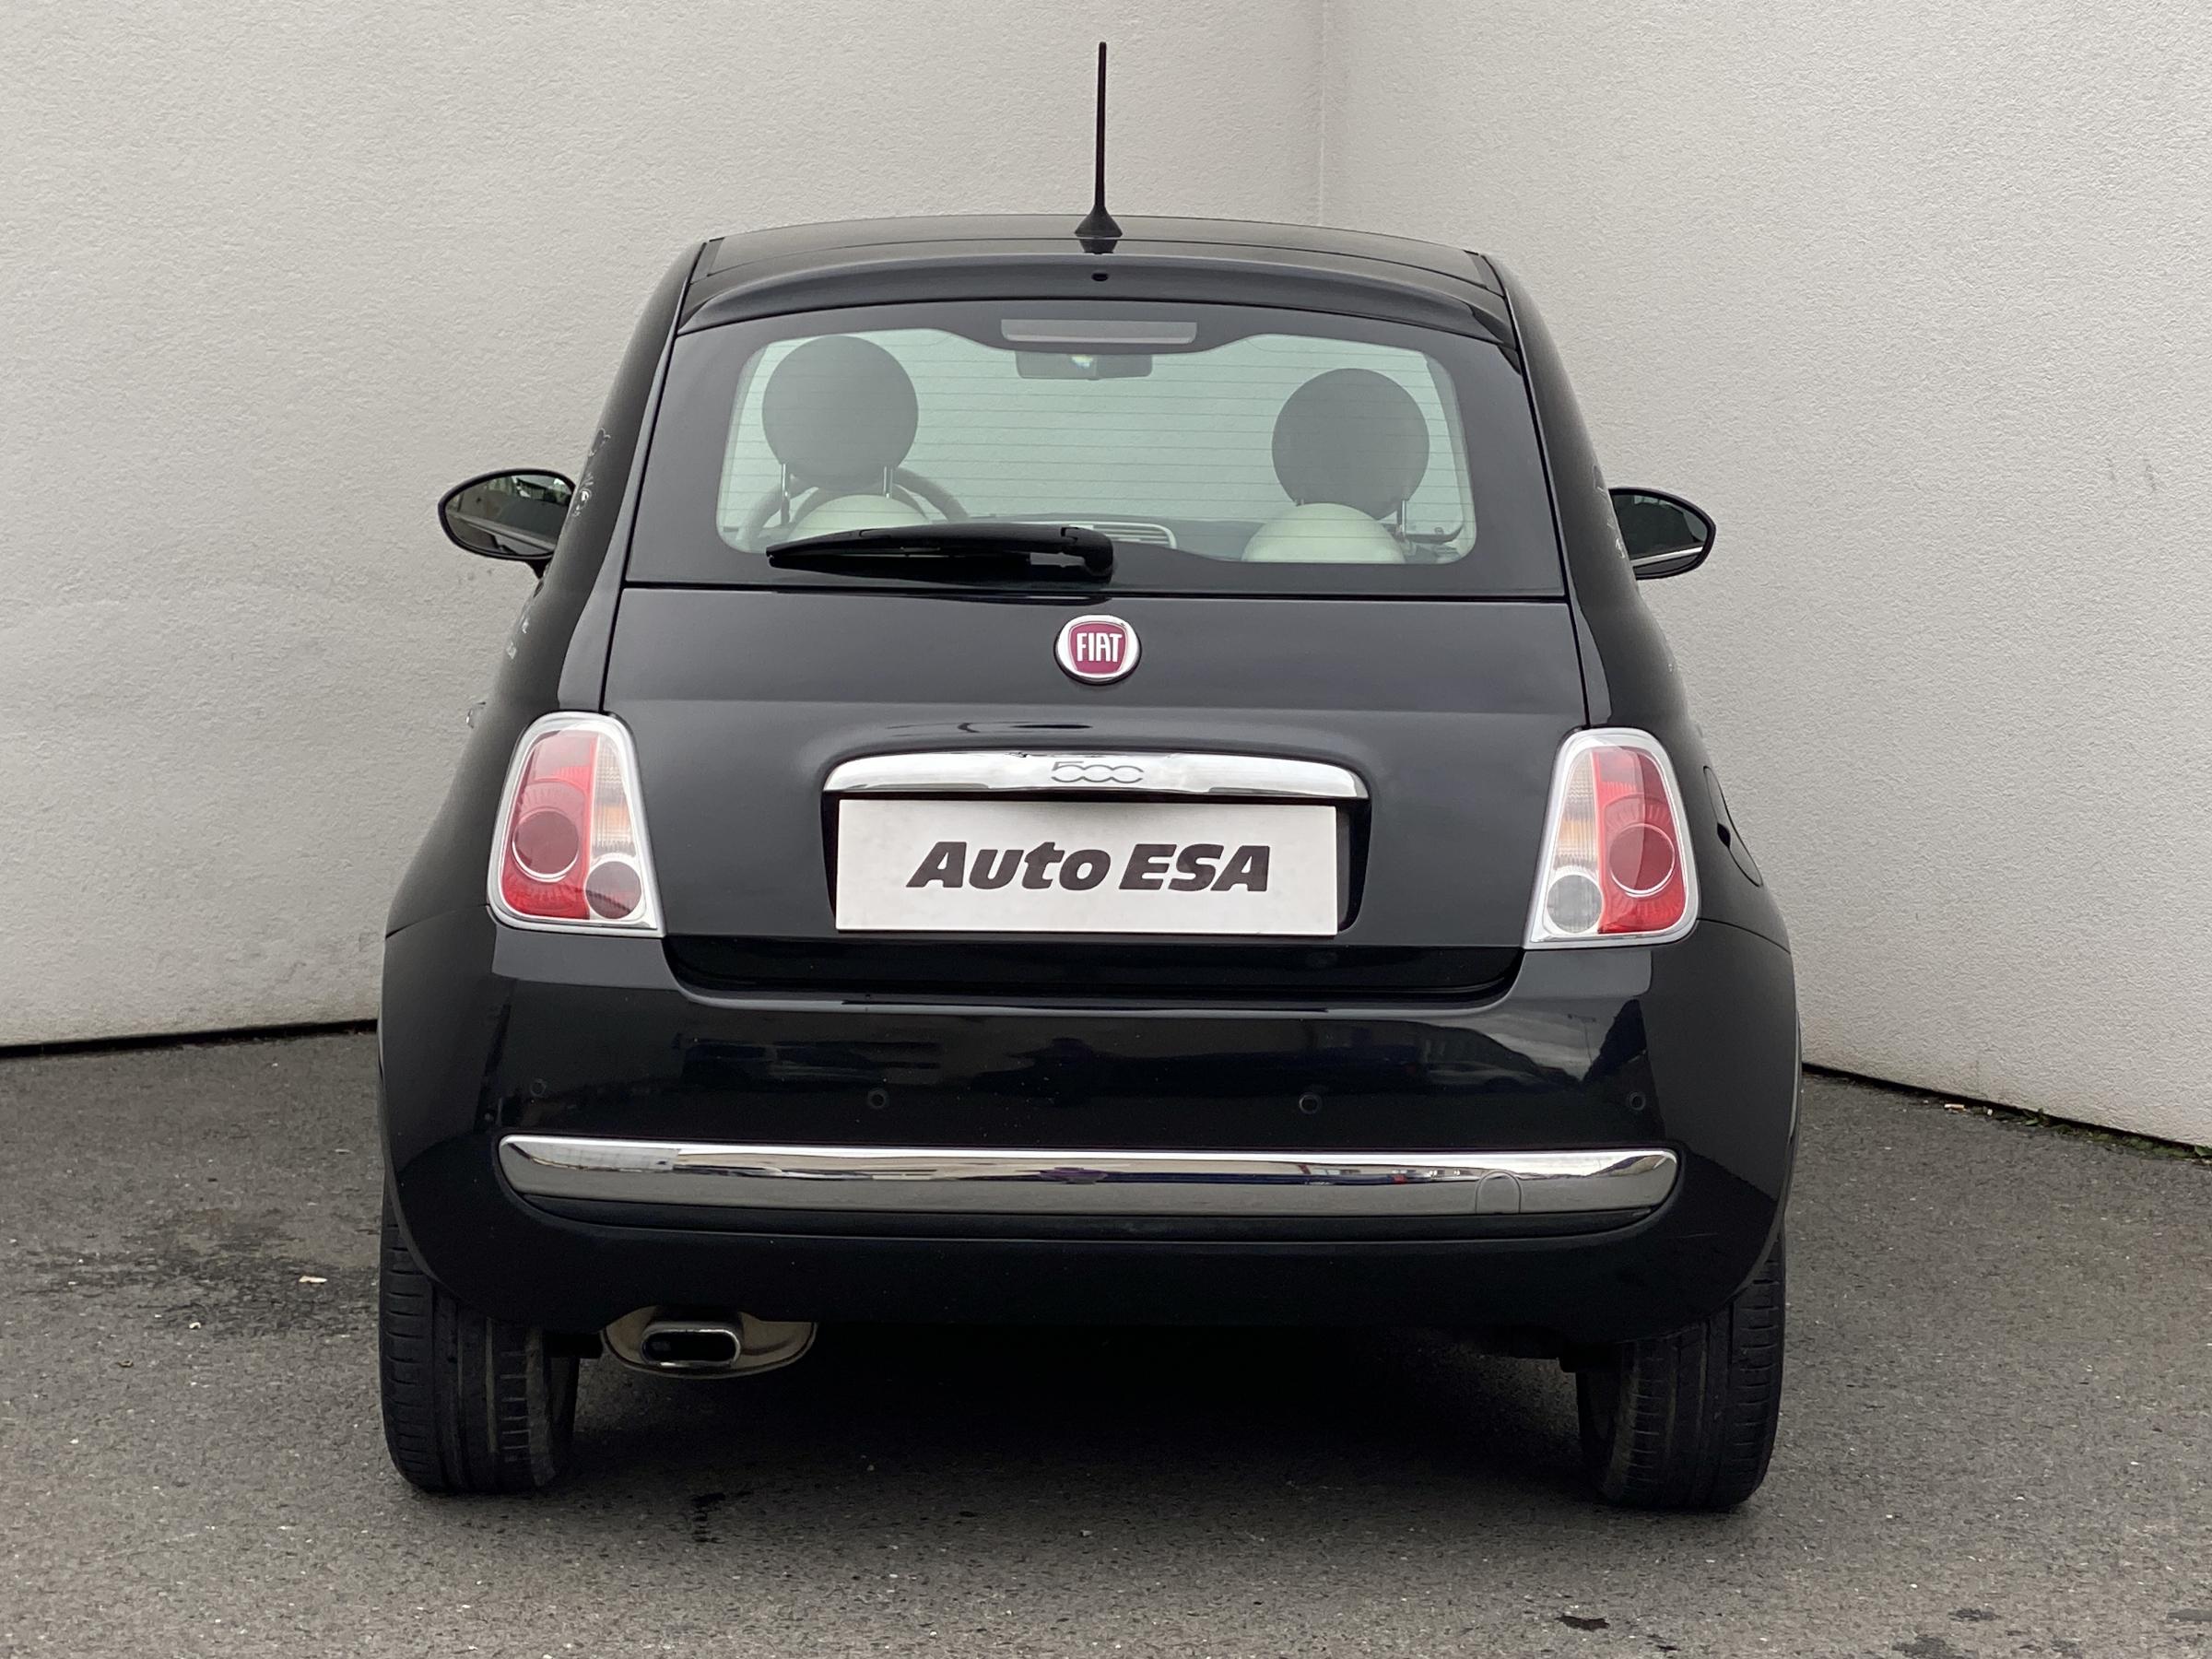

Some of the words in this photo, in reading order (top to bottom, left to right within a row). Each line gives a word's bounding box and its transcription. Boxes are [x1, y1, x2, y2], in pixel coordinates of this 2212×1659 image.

[1077, 632, 1123, 663] FIAT
[1051, 760, 1144, 783] 500
[905, 841, 1112, 891] Auto
[1118, 842, 1270, 891] ESA
